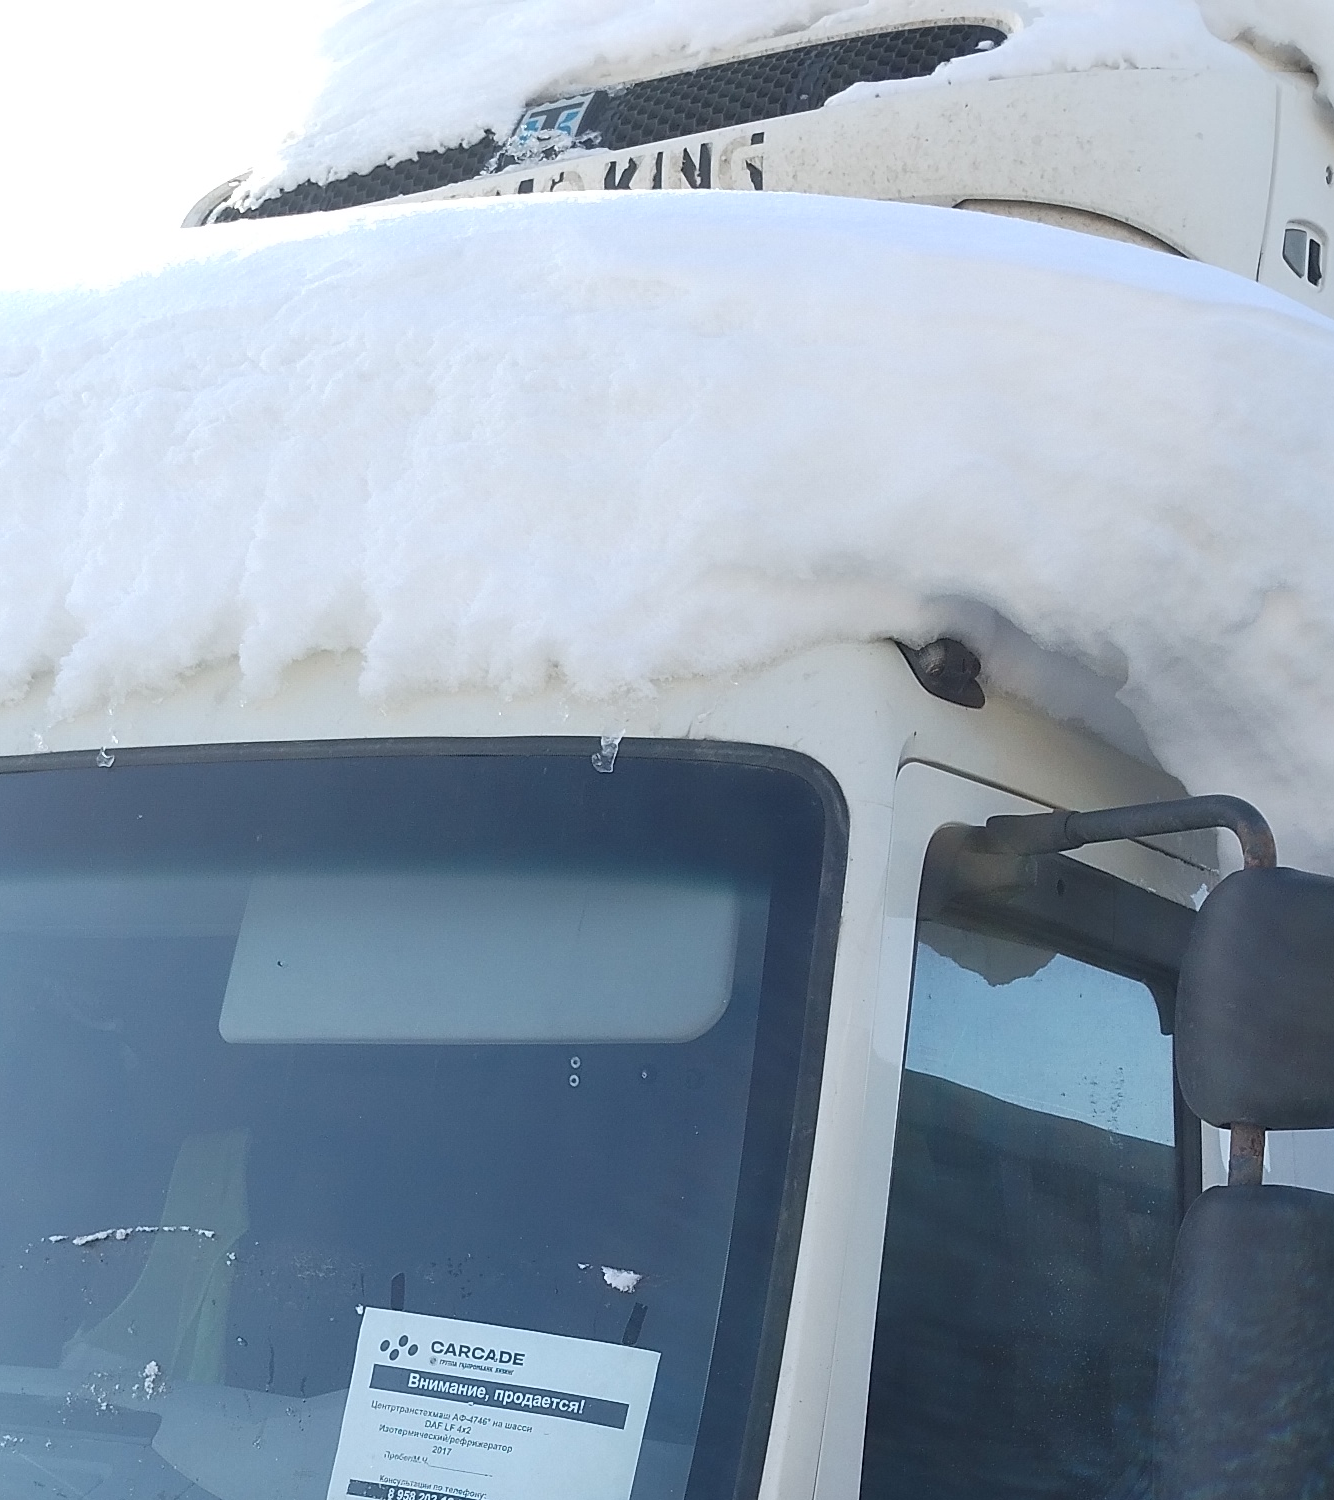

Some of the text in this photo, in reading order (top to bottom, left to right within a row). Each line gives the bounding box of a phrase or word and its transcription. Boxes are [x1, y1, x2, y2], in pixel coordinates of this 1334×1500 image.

[430, 1340, 526, 1367] CARCADE
[407, 1372, 586, 1415] Внимание, продается!
[424, 1419, 444, 1431] DAF
[444, 1422, 456, 1432] LF
[492, 1419, 504, 1429] на
[504, 1422, 533, 1434] шасси
[431, 1445, 453, 1456] 2017
[387, 1487, 396, 1500] 8
